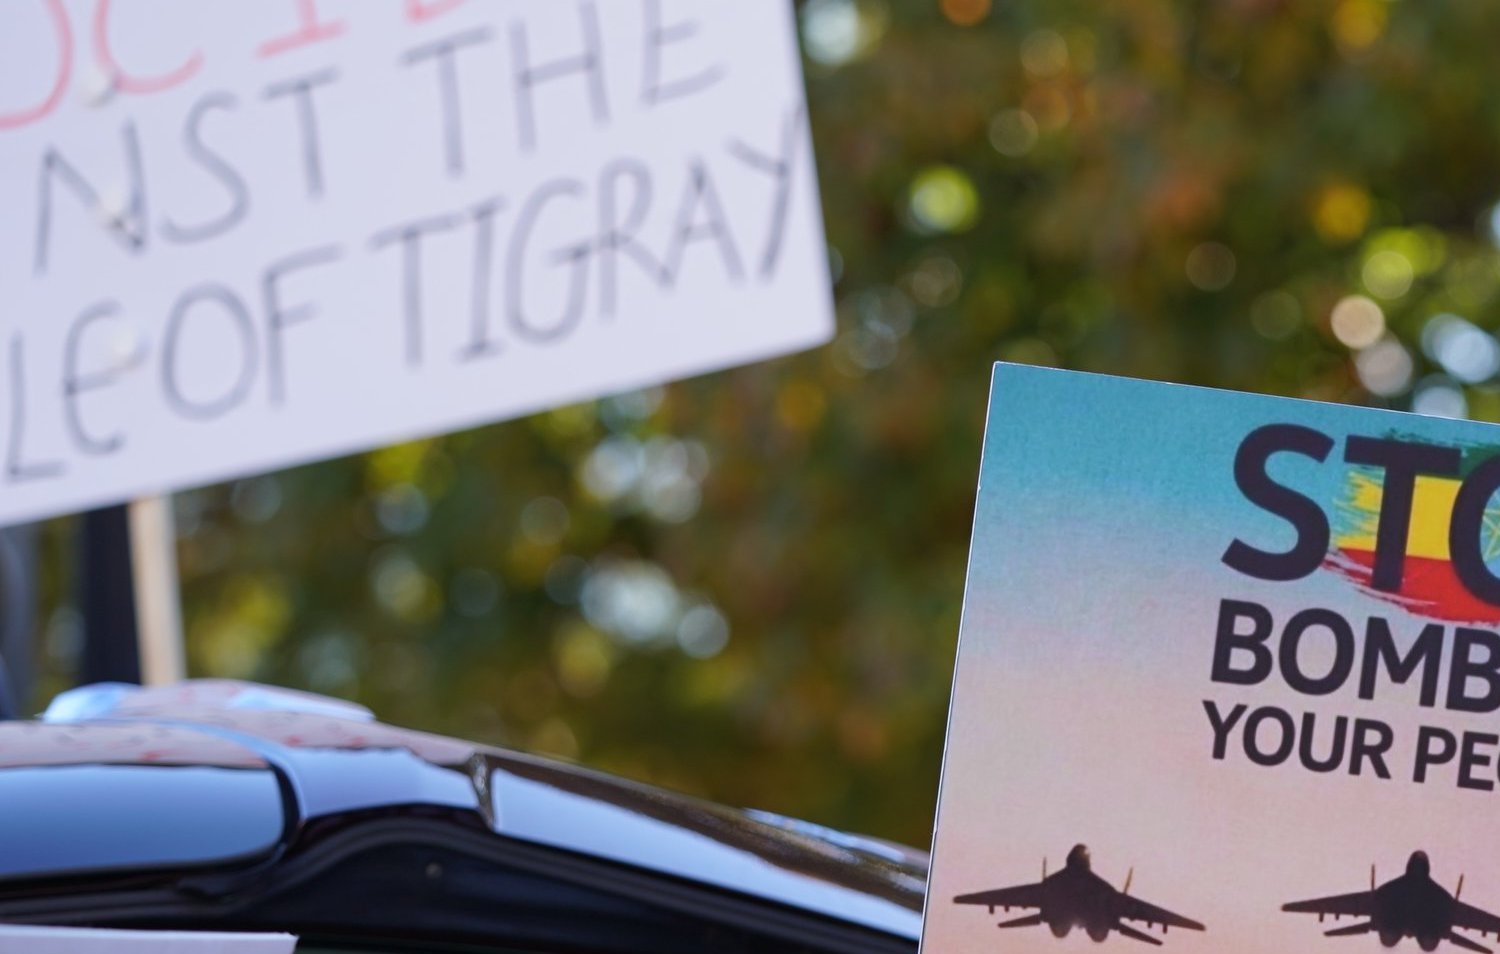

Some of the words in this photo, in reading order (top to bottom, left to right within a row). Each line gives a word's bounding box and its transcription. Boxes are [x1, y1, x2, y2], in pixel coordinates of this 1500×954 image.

[398, 0, 729, 179] THE
[366, 102, 799, 370] TIGRAY
[1202, 700, 1394, 780] YOUR
